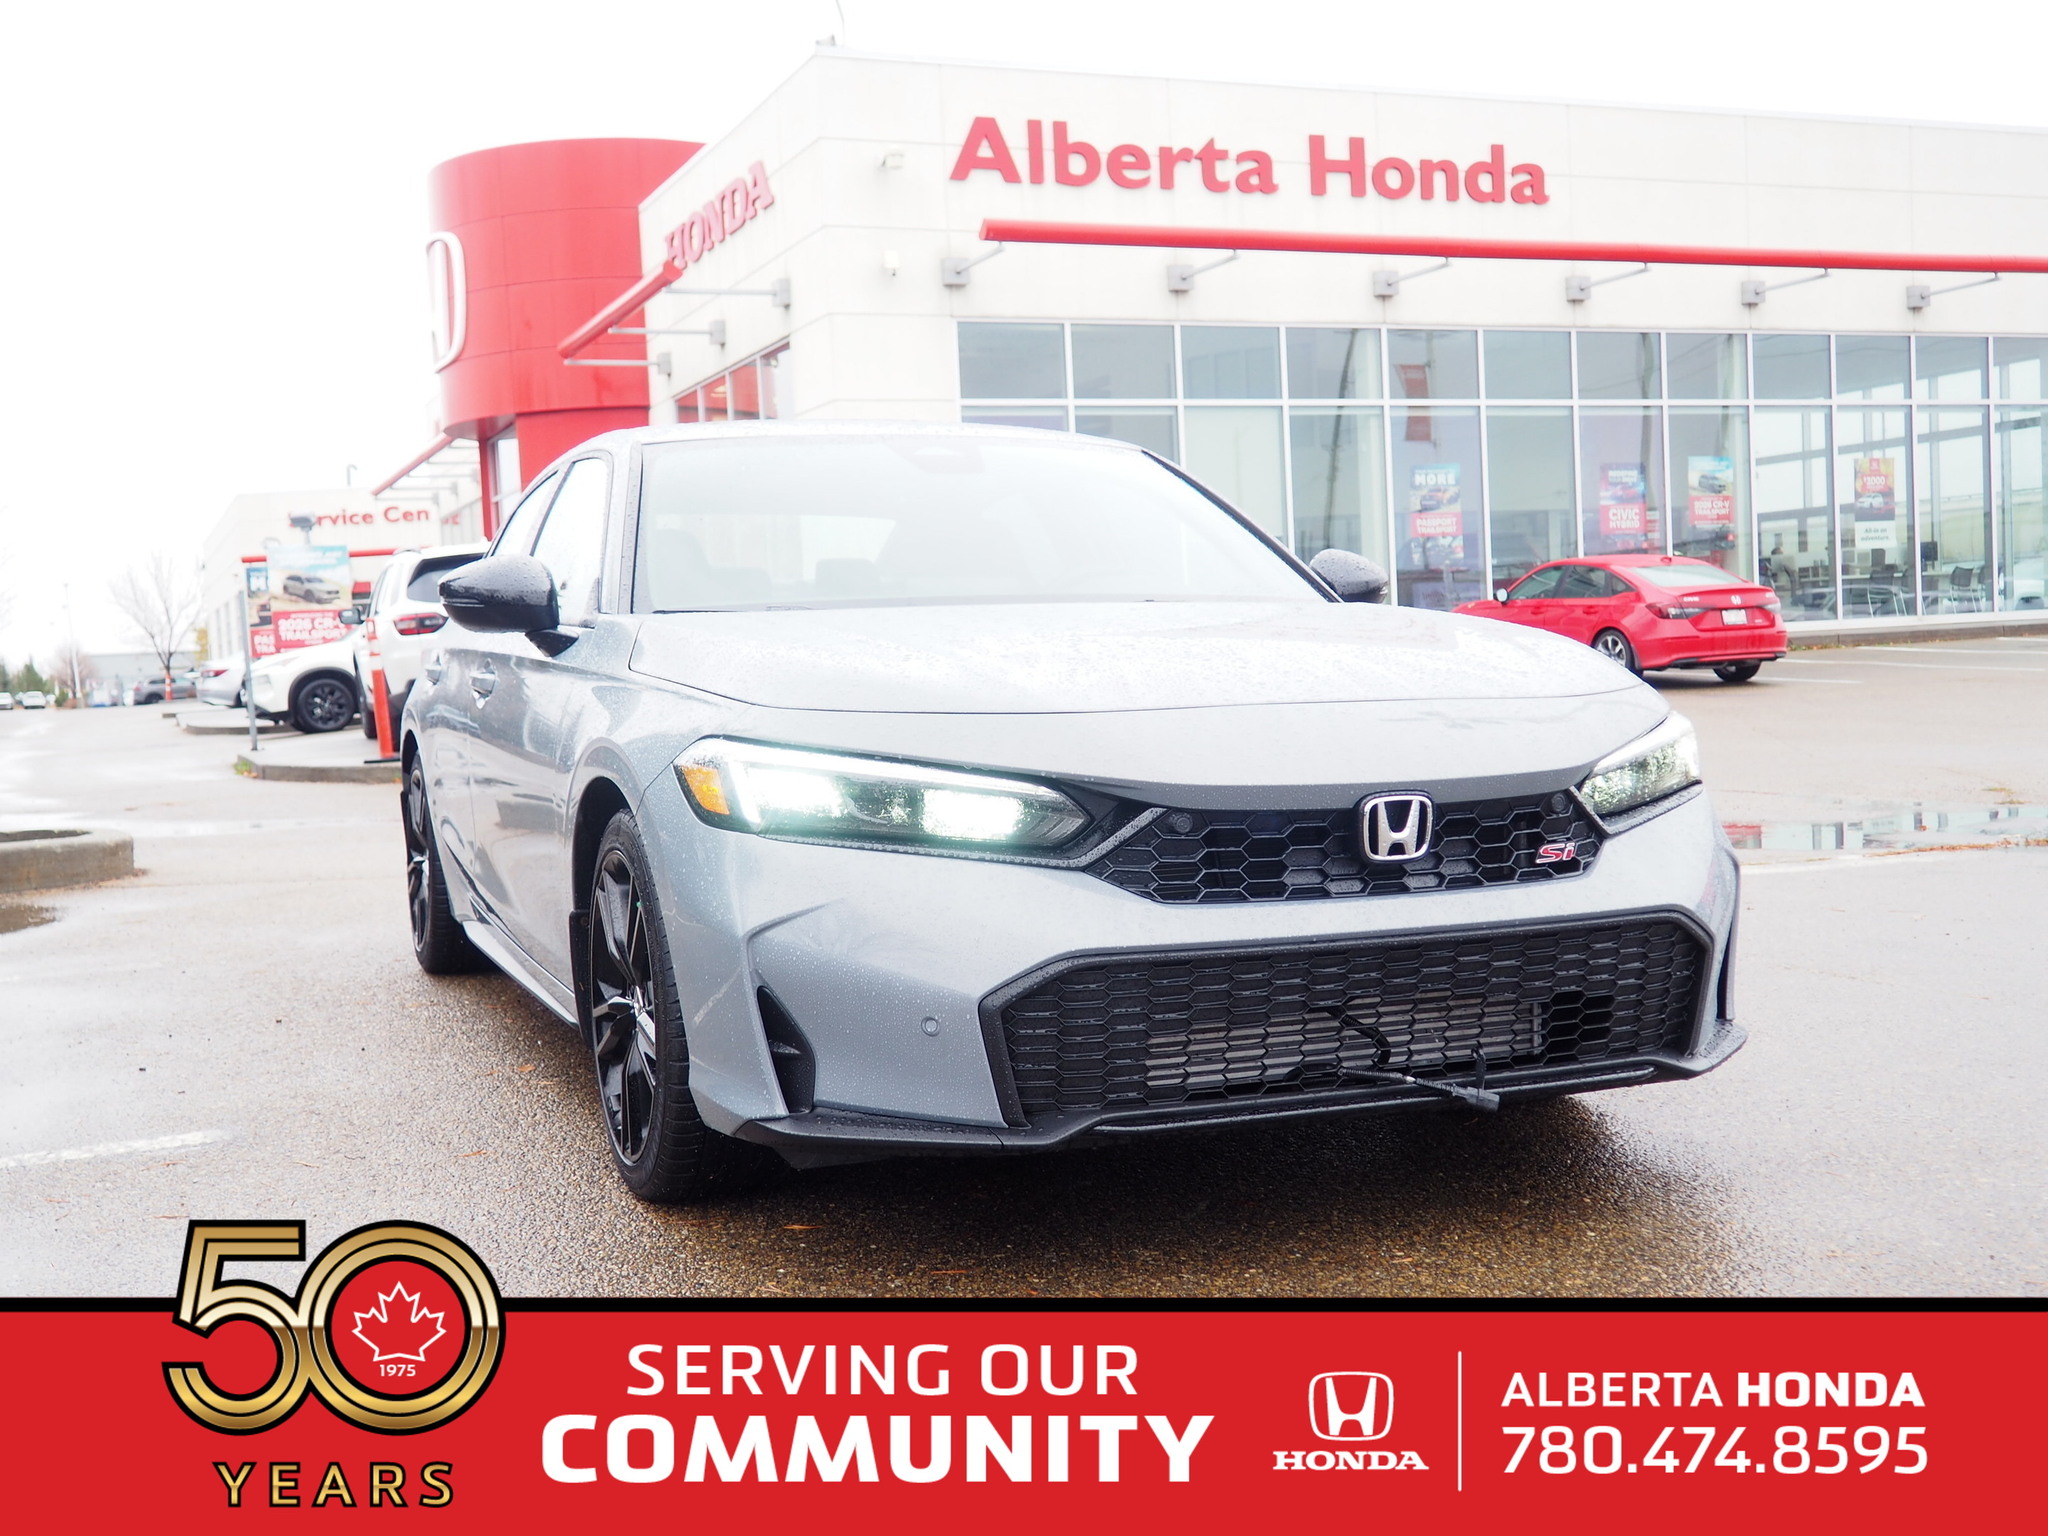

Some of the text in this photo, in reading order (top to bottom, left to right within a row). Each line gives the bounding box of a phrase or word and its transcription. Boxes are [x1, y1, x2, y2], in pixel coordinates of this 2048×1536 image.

[951, 117, 1550, 205] Alberta Honda
[664, 160, 776, 270] HONDA
[1414, 474, 1455, 485] MORE
[288, 508, 374, 528] rvice
[1608, 508, 1640, 520] CIVIC
[1609, 520, 1640, 528] HYBRID
[1535, 841, 1577, 865] Si
